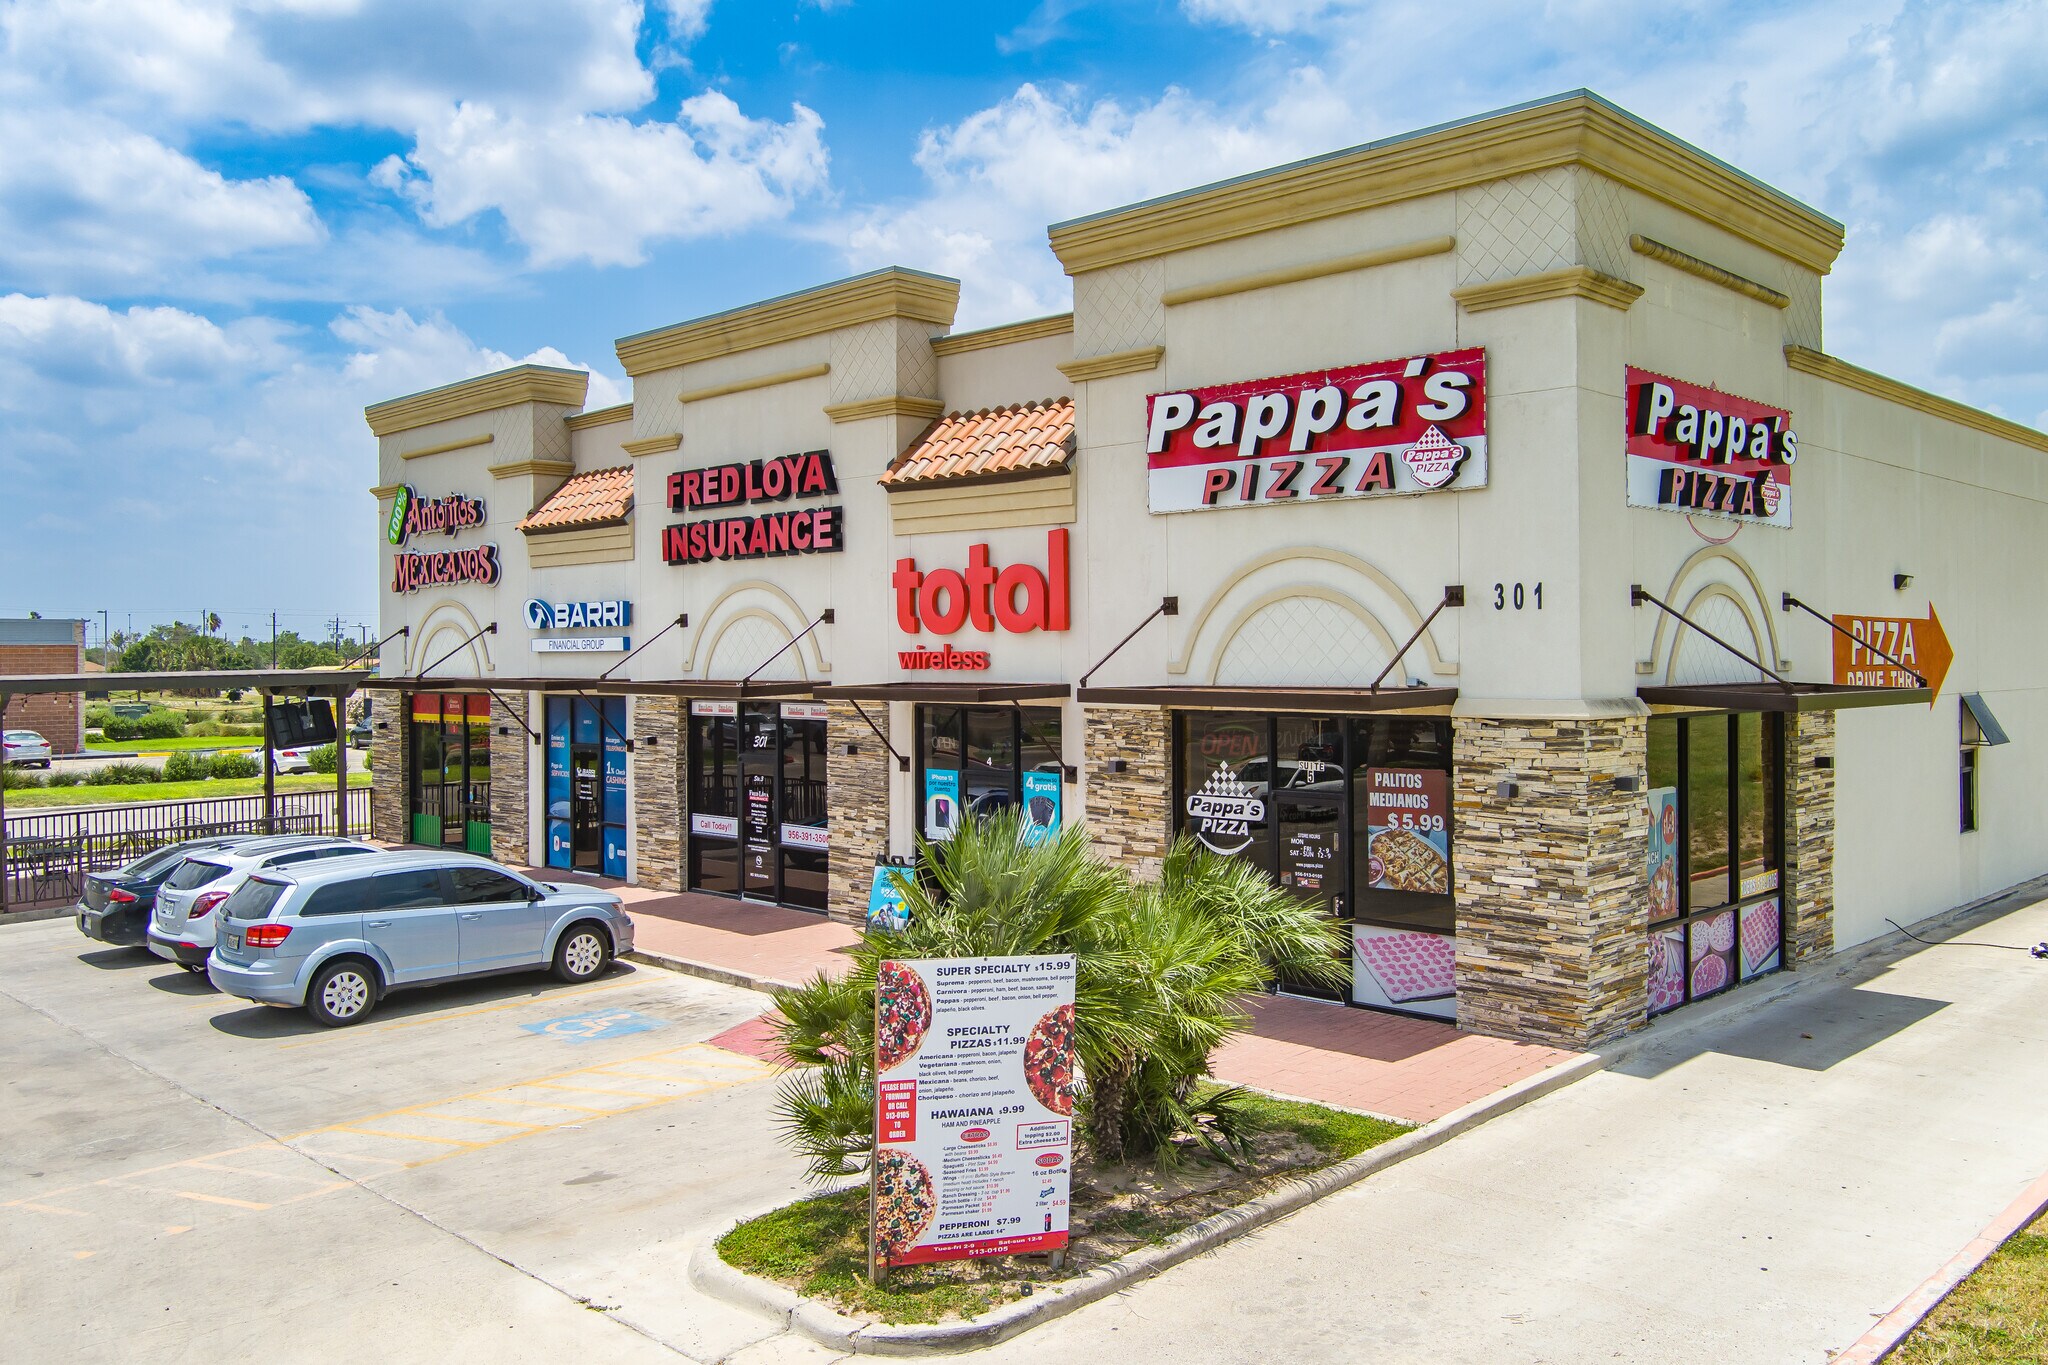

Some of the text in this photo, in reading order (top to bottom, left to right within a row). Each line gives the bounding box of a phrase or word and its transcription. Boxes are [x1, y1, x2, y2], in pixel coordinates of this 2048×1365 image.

[1147, 357, 1471, 456] Pappa's
[1645, 382, 1798, 465] Pappa's
[1406, 447, 1460, 462] Pappa's
[1416, 462, 1450, 473] PIZZA
[667, 454, 829, 508] FRED LOYA
[1203, 452, 1393, 504] PIZZA
[1670, 468, 1754, 515] PIZZA
[389, 490, 408, 541] 100%
[405, 495, 480, 535] Antojitos
[662, 509, 834, 562] INSURANCE
[391, 545, 494, 593] MEXICANOS
[892, 528, 1070, 635] total
[1494, 582, 1544, 610] 301
[554, 601, 626, 629] BARRI
[548, 640, 604, 650] FINANCIAL GROUP
[1851, 619, 1916, 666] PIZZA
[898, 644, 990, 670] wireless
[754, 735, 768, 748] 301
[1201, 733, 1259, 756] OPEN
[986, 757, 992, 766] 4
[1299, 762, 1324, 771] SUITE
[1026, 776, 1034, 790] 4
[1308, 771, 1314, 782] 5
[1374, 772, 1422, 788] PALITOS
[1034, 783, 1057, 792] gratis
[1189, 797, 1260, 817] Pappa's
[1370, 792, 1429, 809] MEDIANOS
[700, 820, 732, 832] Call Today!!
[1200, 818, 1250, 836] PIZZA
[936, 961, 1070, 976] SUPER SPECIALTY $15.99
[947, 1024, 1010, 1036] SPECIALTY
[950, 1036, 1026, 1049] PIZZAS $11.99
[882, 1084, 900, 1092] PLEASE
[886, 1092, 910, 1100] FORWARD
[886, 1111, 910, 1120] 513-0105
[931, 1105, 1026, 1120] HAWAIANA $9.99
[970, 1118, 1000, 1126] PINEAPPLE
[888, 1130, 906, 1138] ORDER
[940, 1216, 1020, 1231] PEPPERONI $7.99
[968, 1246, 1008, 1256] 513-0105
